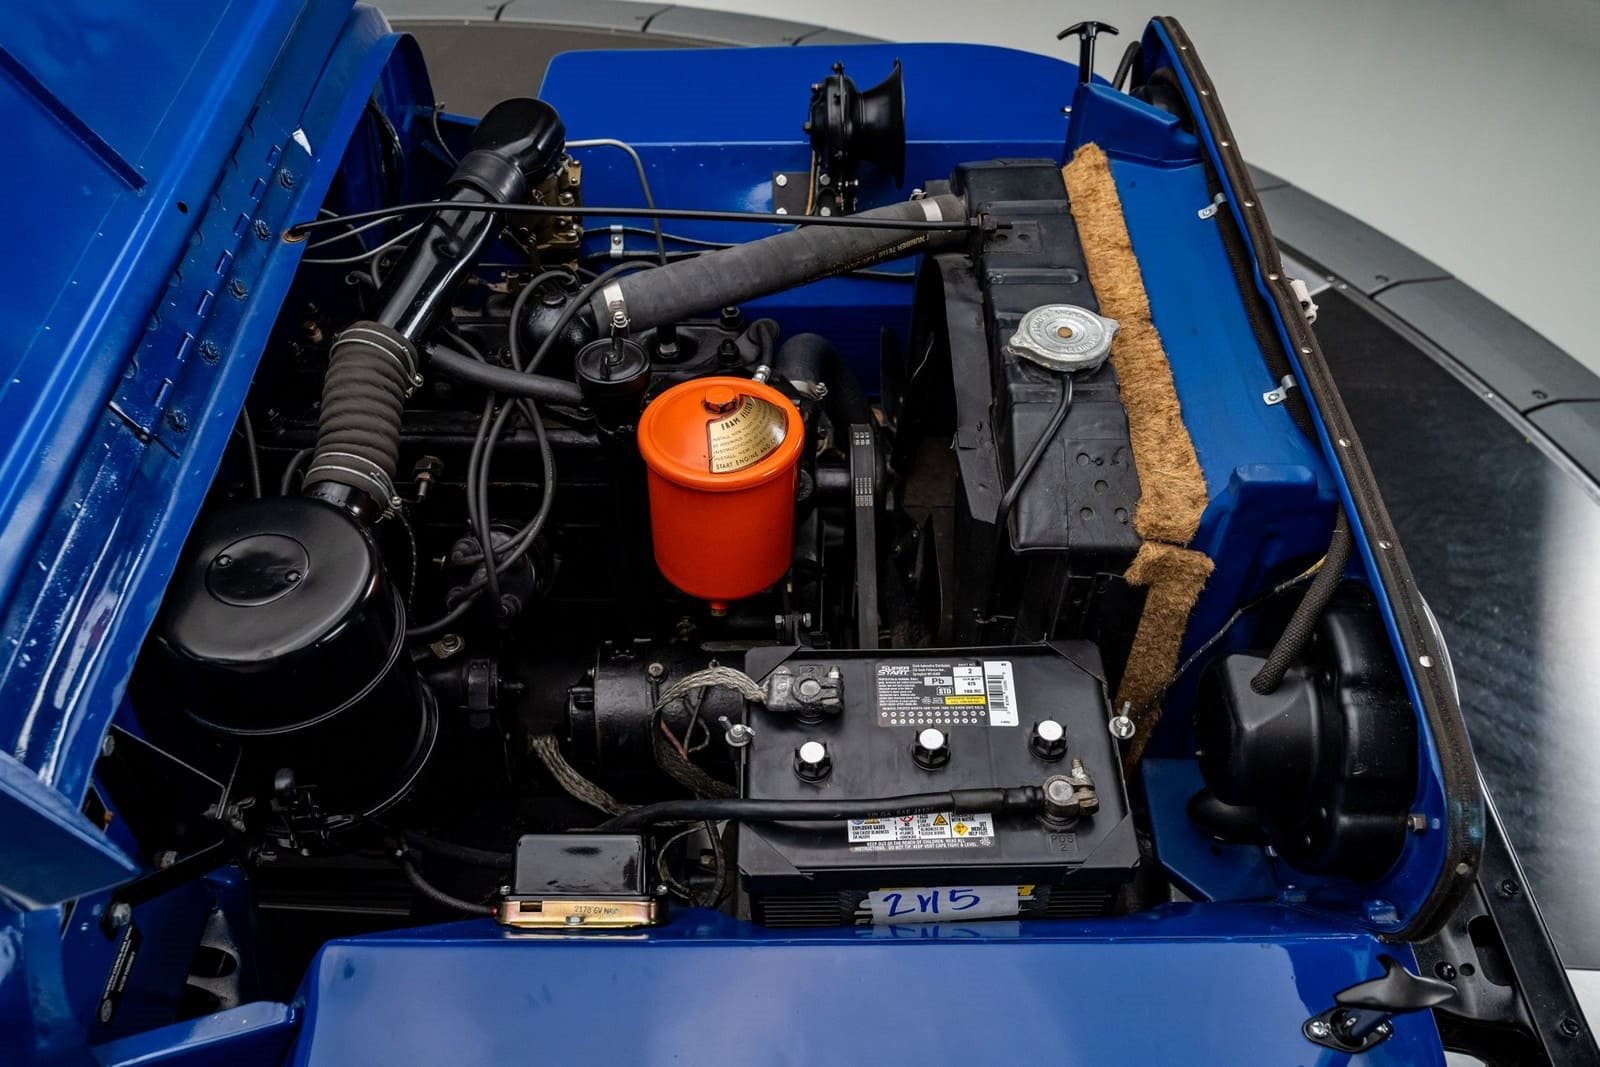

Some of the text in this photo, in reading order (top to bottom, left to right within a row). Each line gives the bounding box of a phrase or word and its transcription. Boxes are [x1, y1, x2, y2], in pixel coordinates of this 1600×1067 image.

[721, 417, 741, 431] FRAM
[715, 461, 733, 470] START
[735, 451, 759, 466] ENGINE
[931, 677, 945, 685] Pb
[1050, 834, 1074, 844] POS
